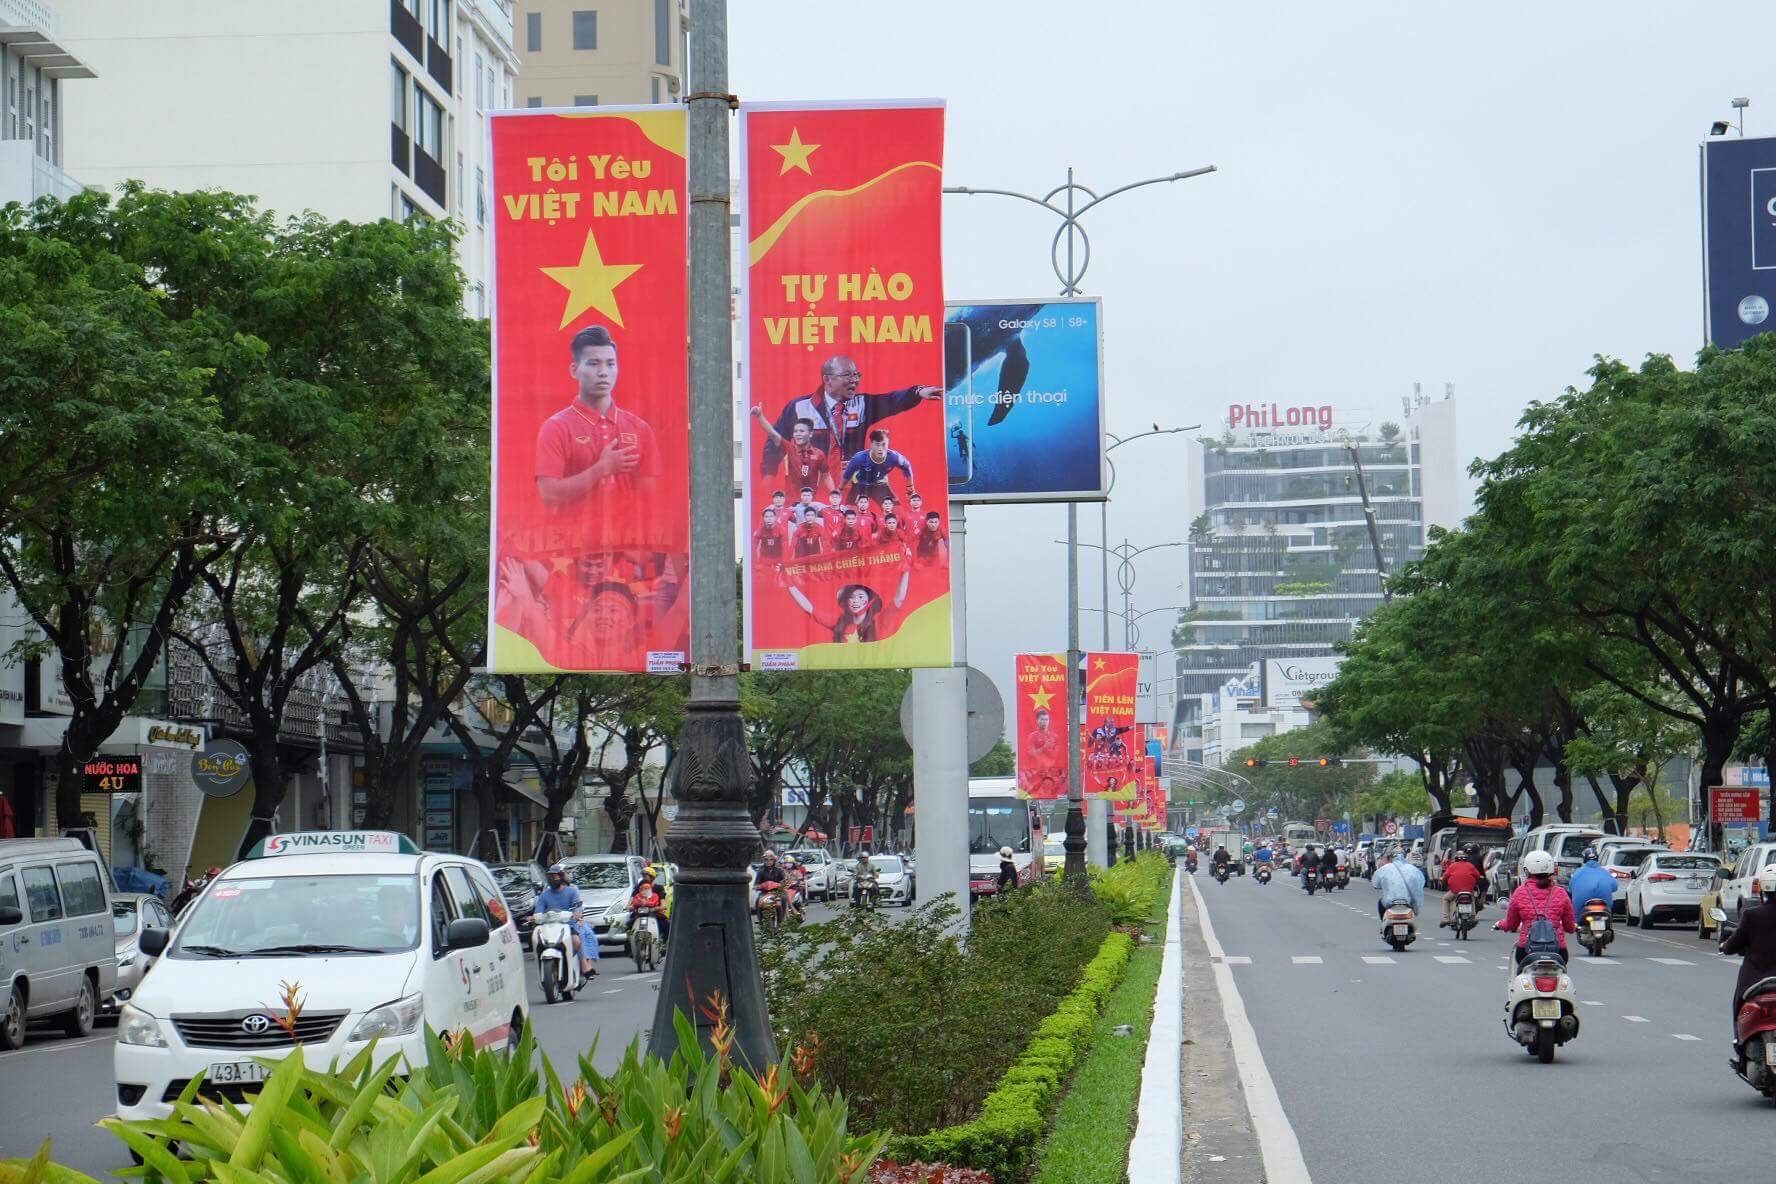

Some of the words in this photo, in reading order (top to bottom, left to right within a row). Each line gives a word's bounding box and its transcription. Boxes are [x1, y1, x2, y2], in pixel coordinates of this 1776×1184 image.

[527, 155, 579, 182] Tôi
[588, 154, 651, 180] Yêu
[503, 188, 581, 226] VIỆT
[593, 189, 677, 217] NAM
[781, 274, 828, 311] TỰ
[838, 267, 914, 302] HÀO
[763, 310, 839, 352] VIỆT
[851, 315, 933, 344] NAM
[998, 318, 1041, 330] Galaxy
[1043, 318, 1057, 328] S8
[1068, 316, 1088, 328] S8+
[988, 388, 1023, 408] điện
[1025, 388, 1068, 407] thoại
[84, 761, 114, 775] NƯỚC
[116, 763, 139, 775] HOA
[99, 776, 125, 790] 4U
[292, 834, 365, 846] VINASUN
[368, 834, 393, 845] TAXI
